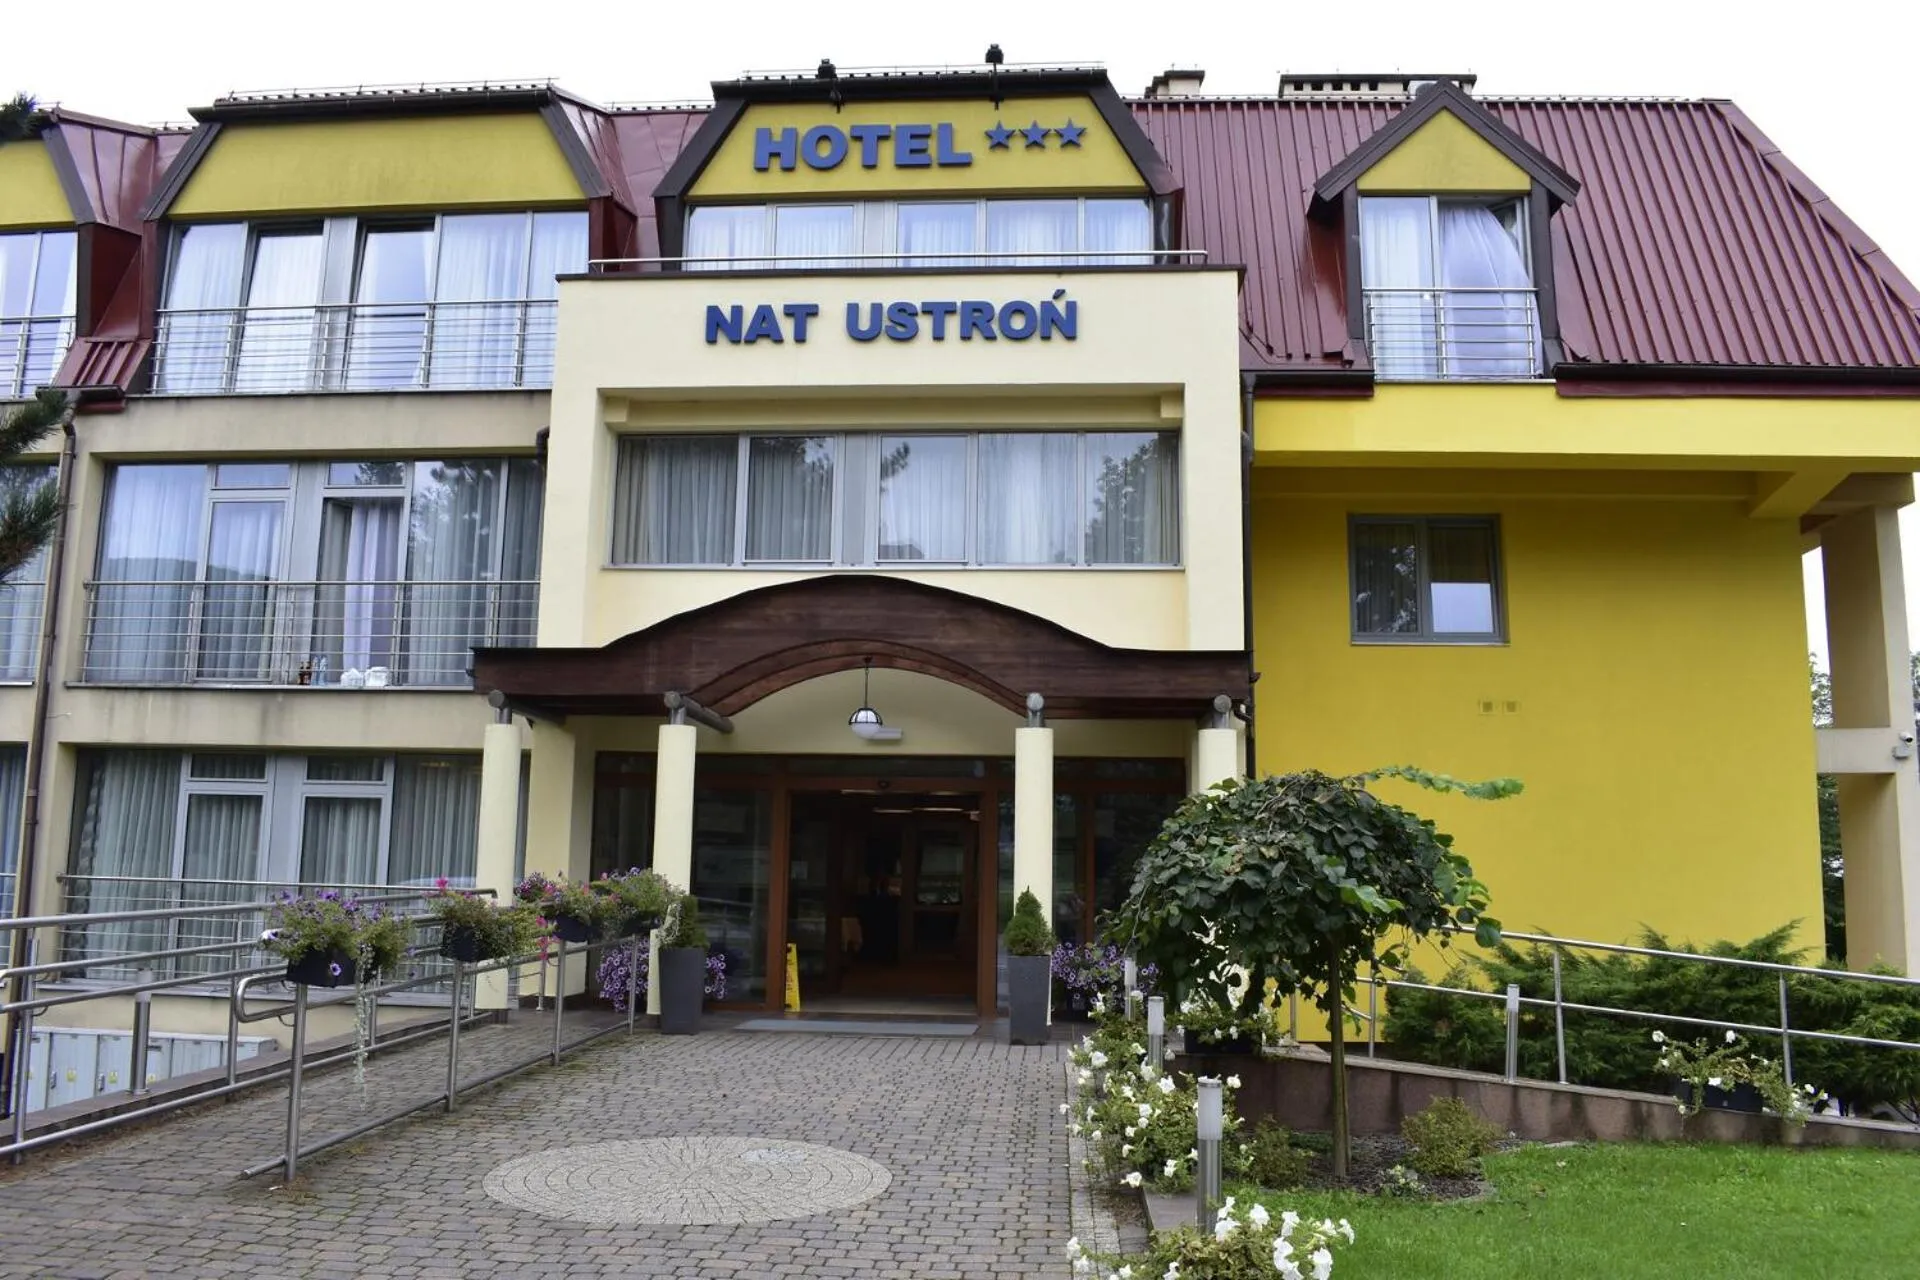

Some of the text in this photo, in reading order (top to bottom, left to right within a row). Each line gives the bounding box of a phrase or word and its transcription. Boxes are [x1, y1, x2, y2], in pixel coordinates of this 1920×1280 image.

[754, 122, 973, 171] HOTEL
[704, 289, 1078, 344] NAT USTROŃ
